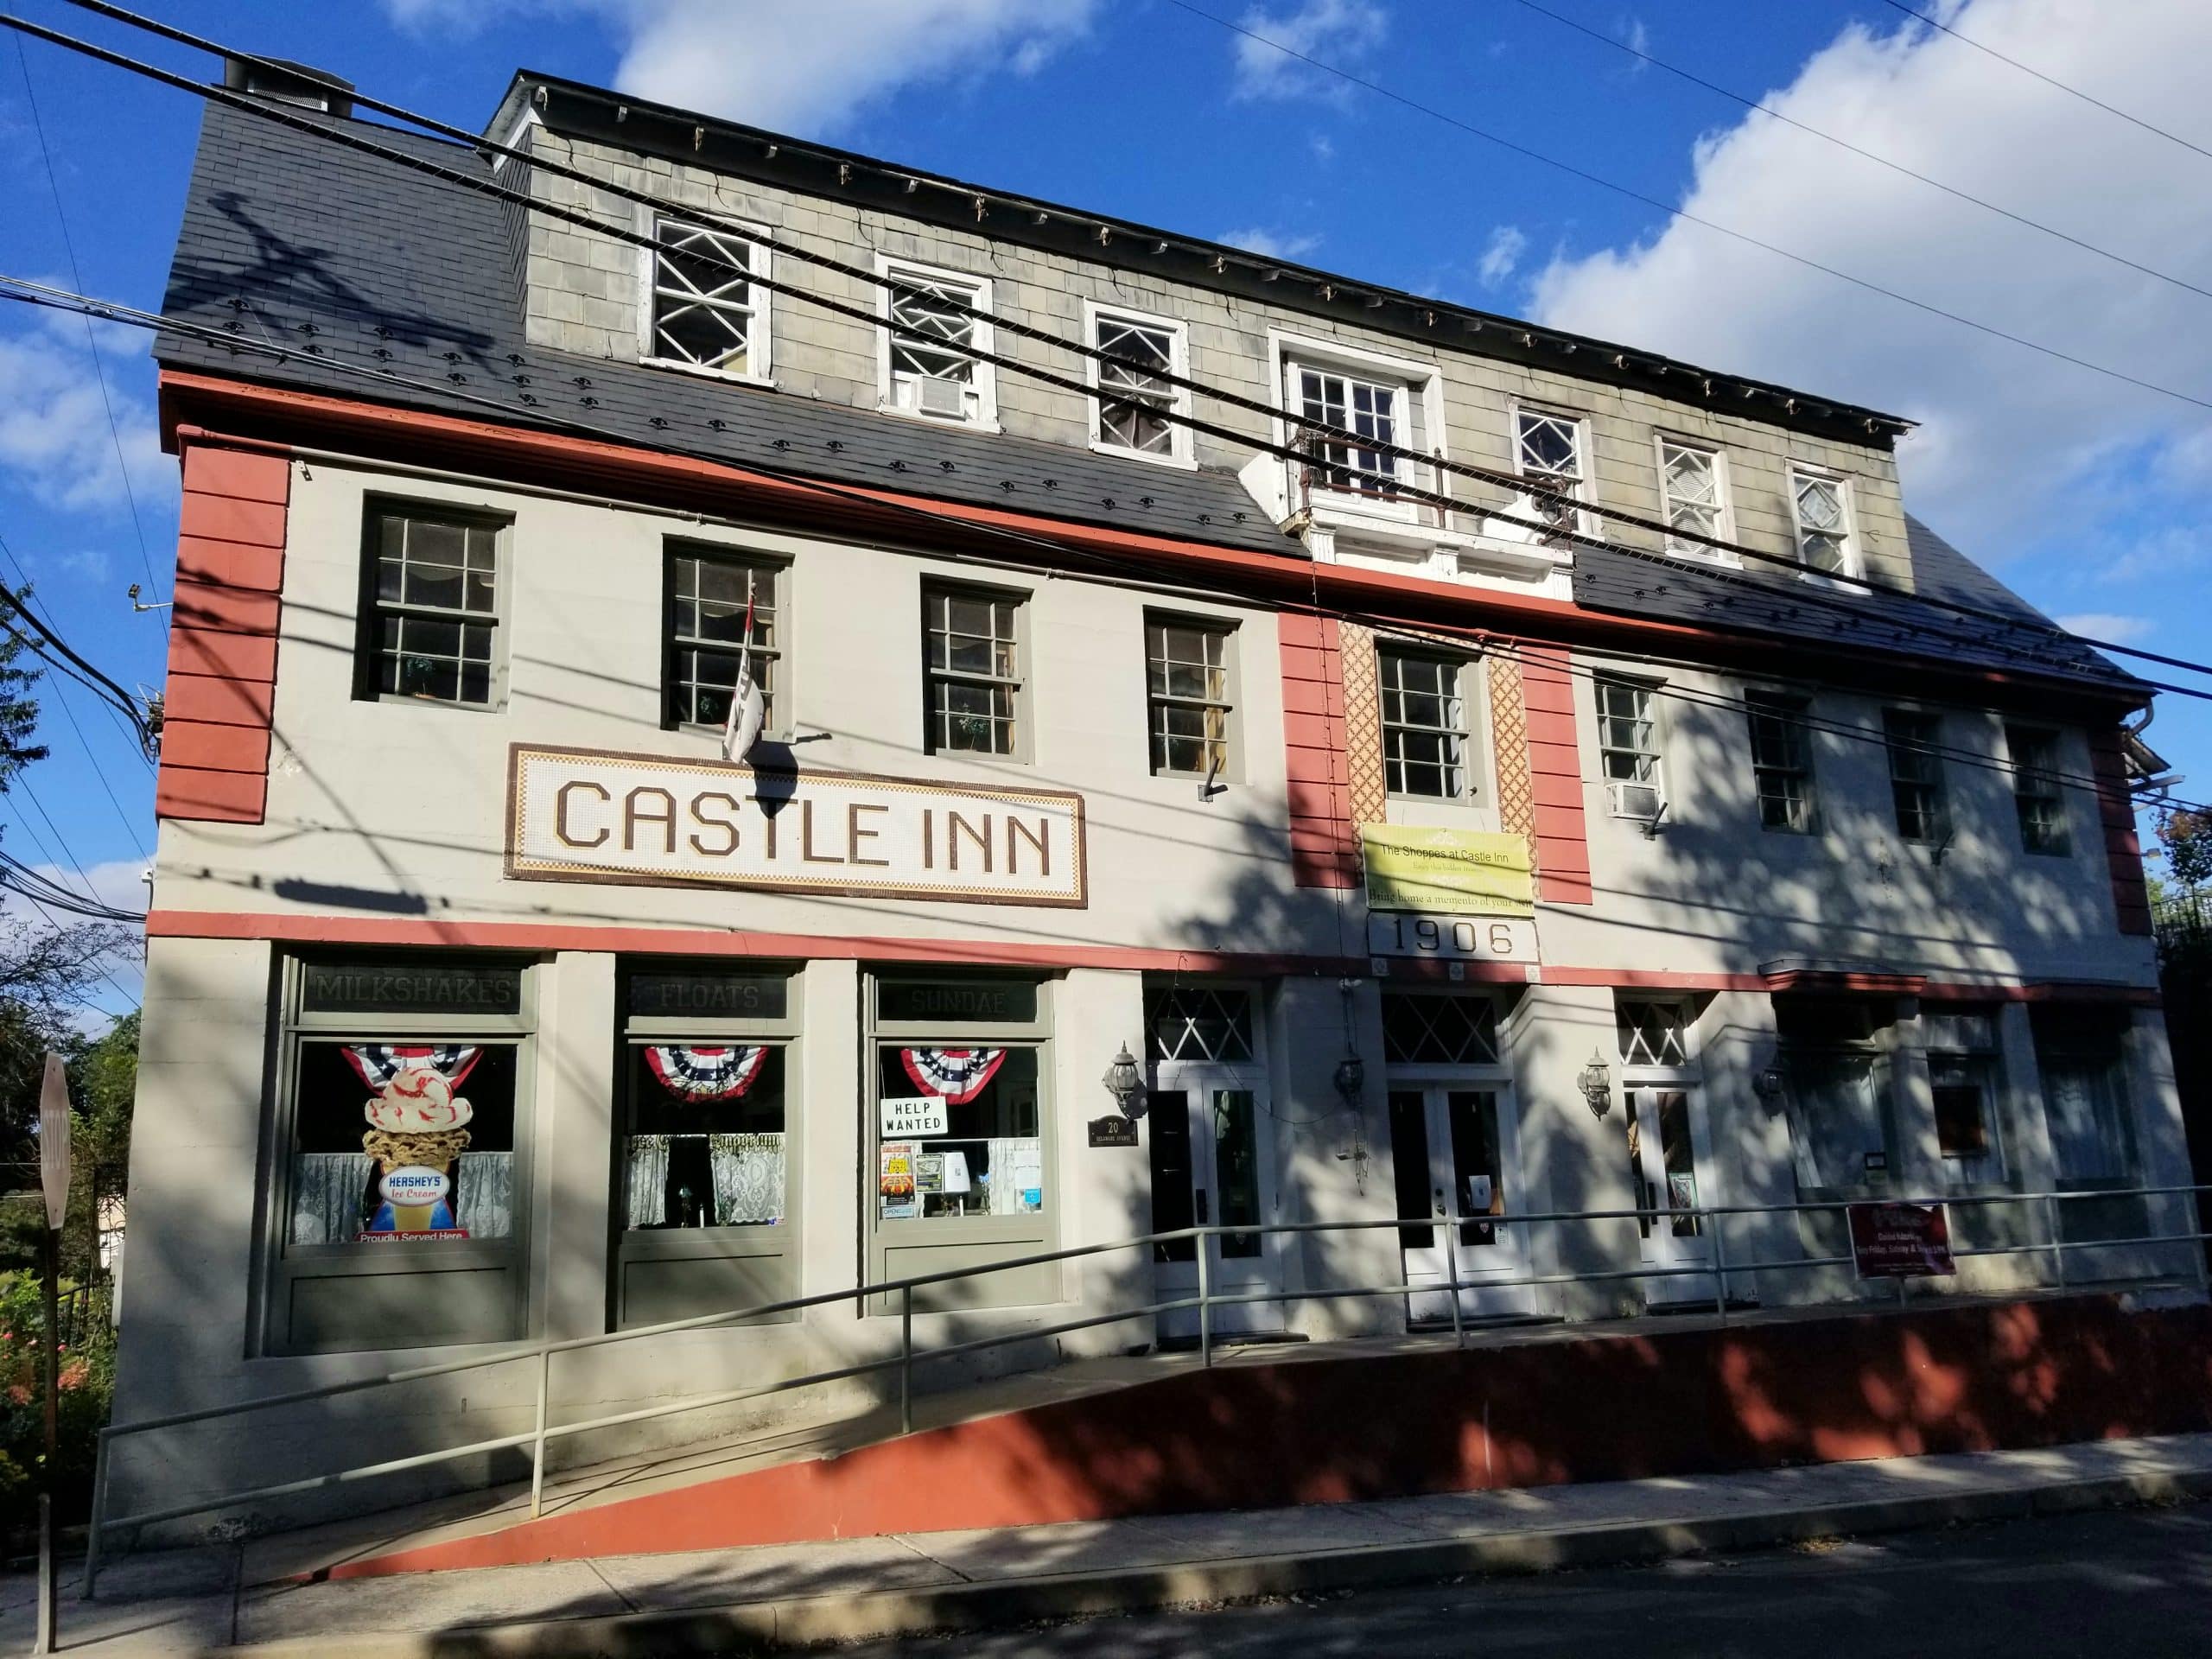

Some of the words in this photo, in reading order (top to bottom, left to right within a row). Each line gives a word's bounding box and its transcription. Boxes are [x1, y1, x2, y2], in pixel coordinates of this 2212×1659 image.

[555, 780, 890, 867] CASTLE
[923, 808, 1050, 877] INN
[1382, 845, 1400, 856] The
[1403, 846, 1446, 861] Shoppes
[1449, 850, 1459, 860] at
[1461, 849, 1491, 862] Castle
[1495, 852, 1509, 863] Inn
[1370, 888, 1395, 903] Bring
[1398, 888, 1424, 903] home
[1434, 895, 1478, 906] memento
[1393, 918, 1513, 954] 1906
[315, 974, 512, 1004] MILKSHAKES
[659, 982, 760, 1009] FLOATS
[895, 1102, 931, 1115] HELP
[887, 1117, 941, 1131] WANTED
[1108, 1122, 1119, 1134] 20
[389, 1175, 442, 1187] HERSHEY'S
[391, 1189, 403, 1198] Ice
[407, 1188, 436, 1198] Cream
[402, 1232, 436, 1241] Served
[439, 1231, 462, 1240] Here
